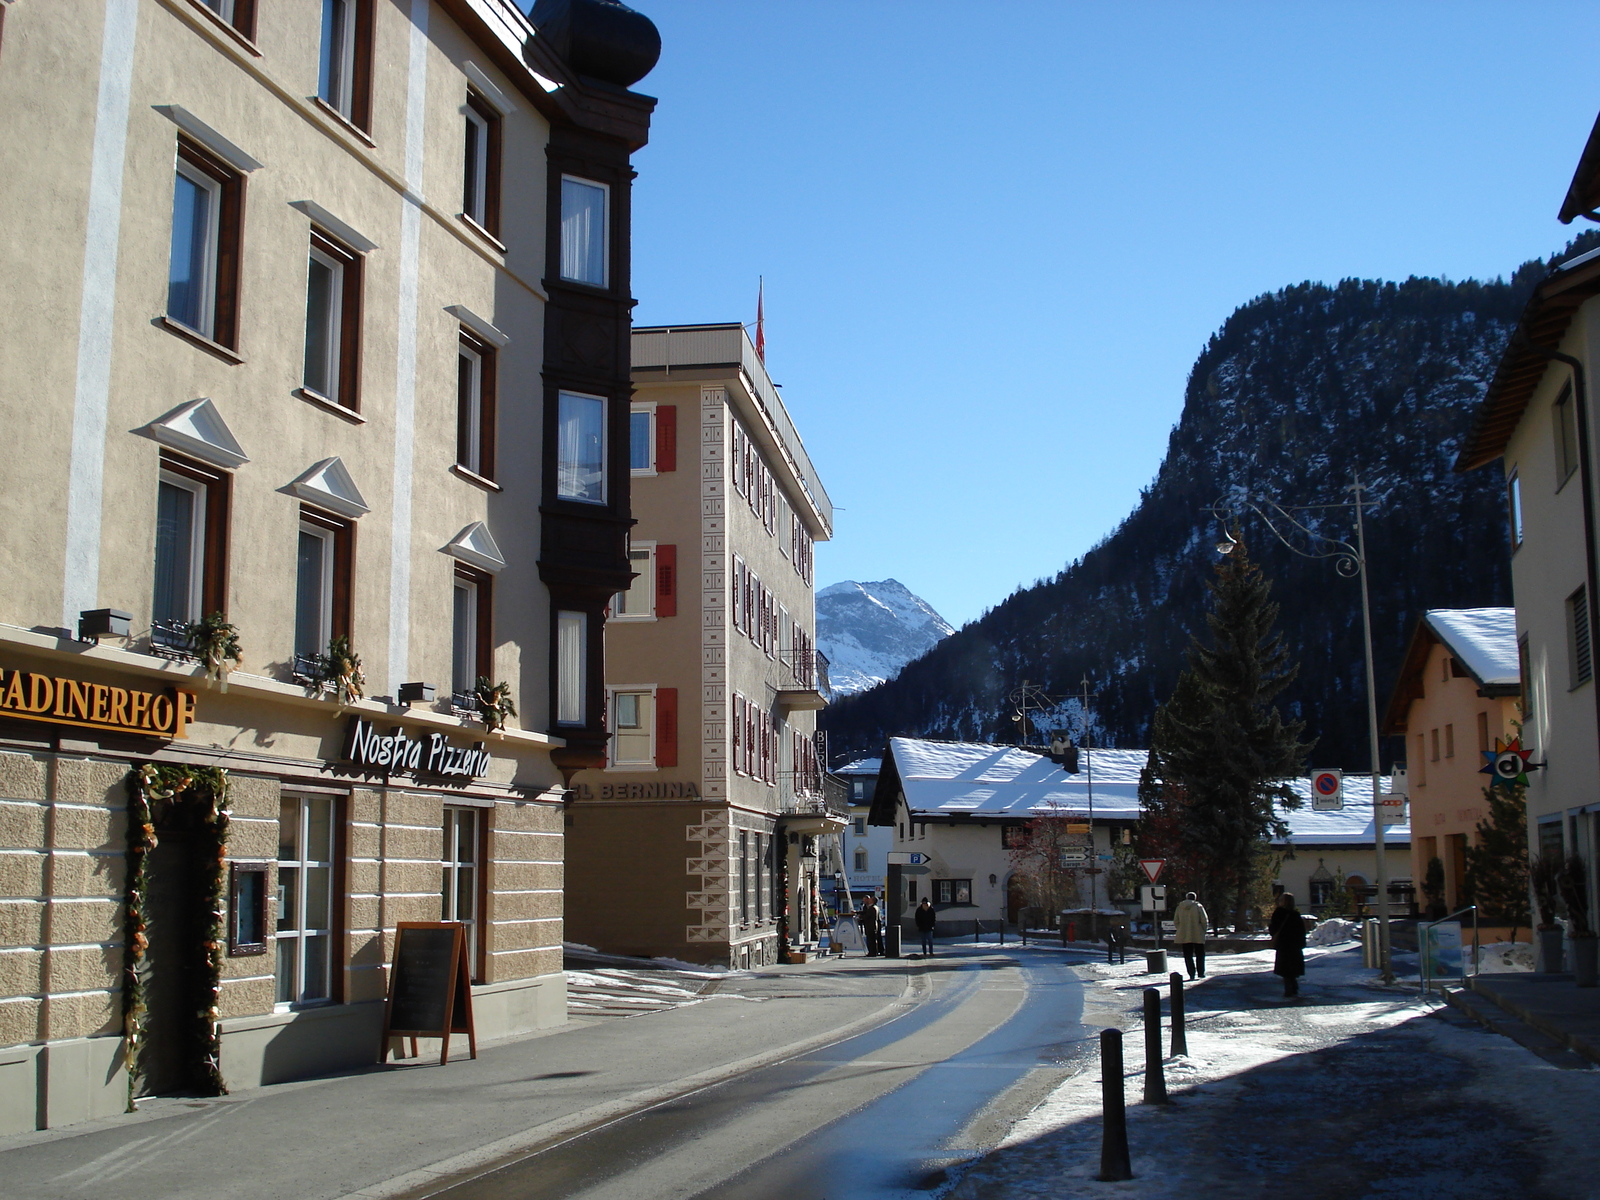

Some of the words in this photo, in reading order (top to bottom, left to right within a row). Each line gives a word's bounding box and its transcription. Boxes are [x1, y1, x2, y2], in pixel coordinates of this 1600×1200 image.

[0, 667, 197, 739] ADINERHOF
[350, 715, 422, 770] Nostra
[428, 733, 491, 777] Pizzeria
[816, 730, 825, 774] BER
[600, 782, 699, 799] BERNINA
